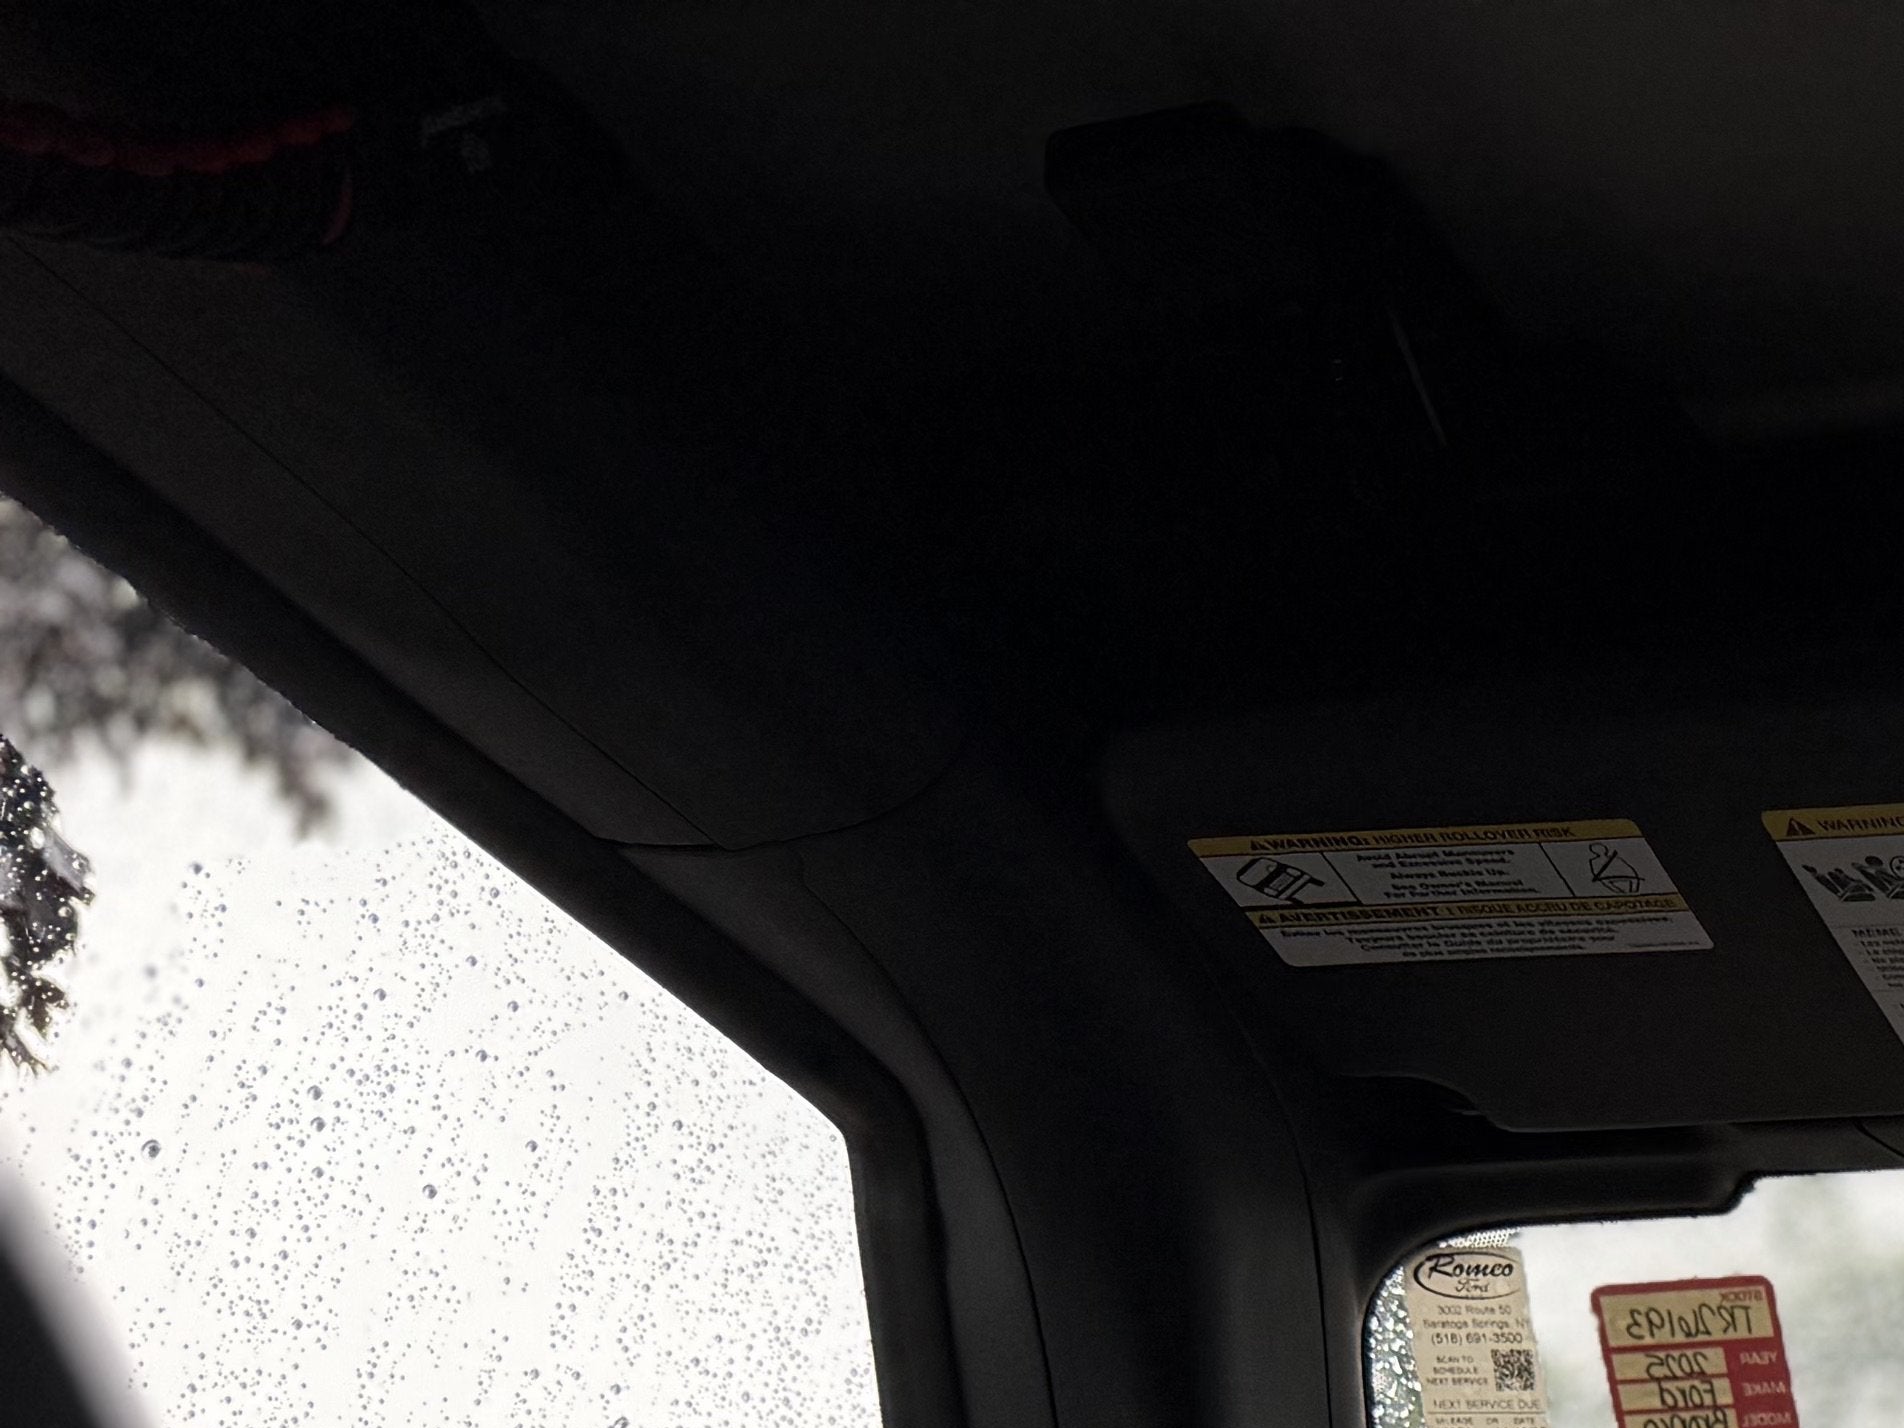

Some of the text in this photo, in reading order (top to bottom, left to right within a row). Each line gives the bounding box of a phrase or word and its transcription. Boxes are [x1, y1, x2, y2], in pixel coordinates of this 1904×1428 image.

[1456, 1278, 1489, 1293] Ford
[1433, 1399, 1540, 1409] NEXT SERVICE DUE
